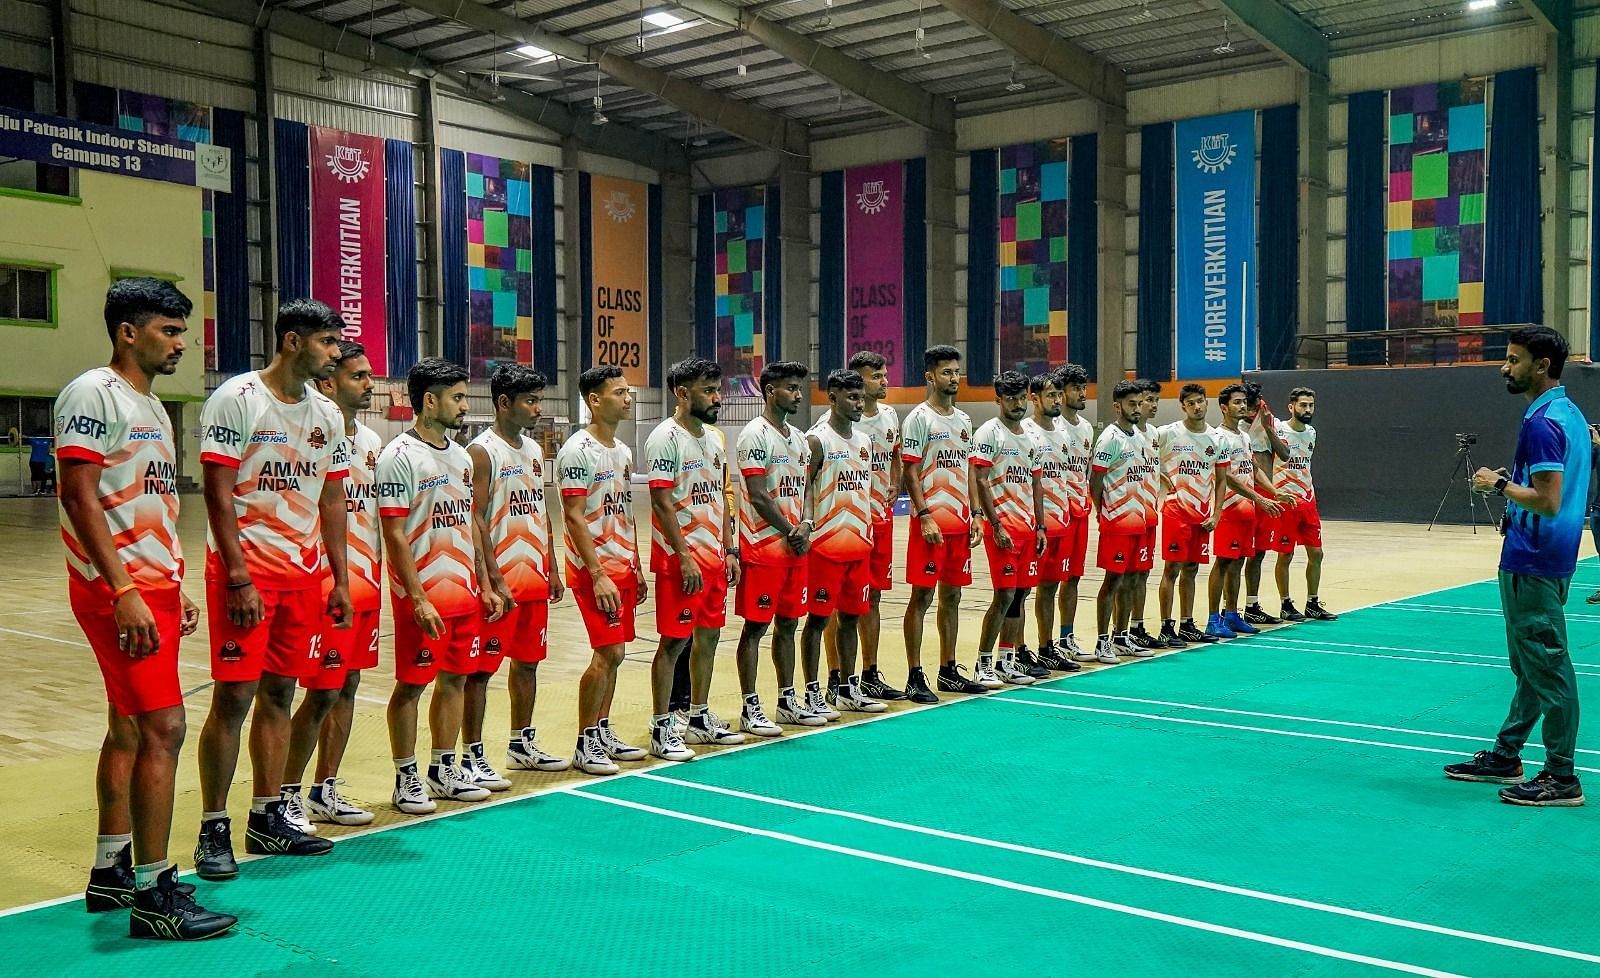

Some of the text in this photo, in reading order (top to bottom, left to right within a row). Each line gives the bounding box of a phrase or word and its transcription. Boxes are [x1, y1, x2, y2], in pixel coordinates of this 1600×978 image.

[24, 118, 83, 142] Patnaik
[86, 130, 135, 151] Indoor
[138, 140, 195, 161] Stadium
[52, 143, 141, 172] Campus 13
[1204, 189, 1226, 362] #FOREVERKIITIAN
[597, 286, 642, 313] CLASS
[850, 283, 896, 310] CLASS
[597, 315, 615, 338] OF
[850, 315, 868, 338] OF
[598, 340, 640, 368] 2023
[205, 425, 242, 446] ABTP
[249, 435, 288, 444] KHO KHO
[936, 460, 962, 468] INDIA
[1178, 468, 1200, 476] INDIA
[144, 480, 176, 496] INDIA
[257, 477, 300, 492] INDIA
[838, 481, 864, 492] INDIA
[1006, 476, 1028, 484] INDIA
[510, 504, 538, 517] INDIA
[432, 514, 467, 529] INDIA
